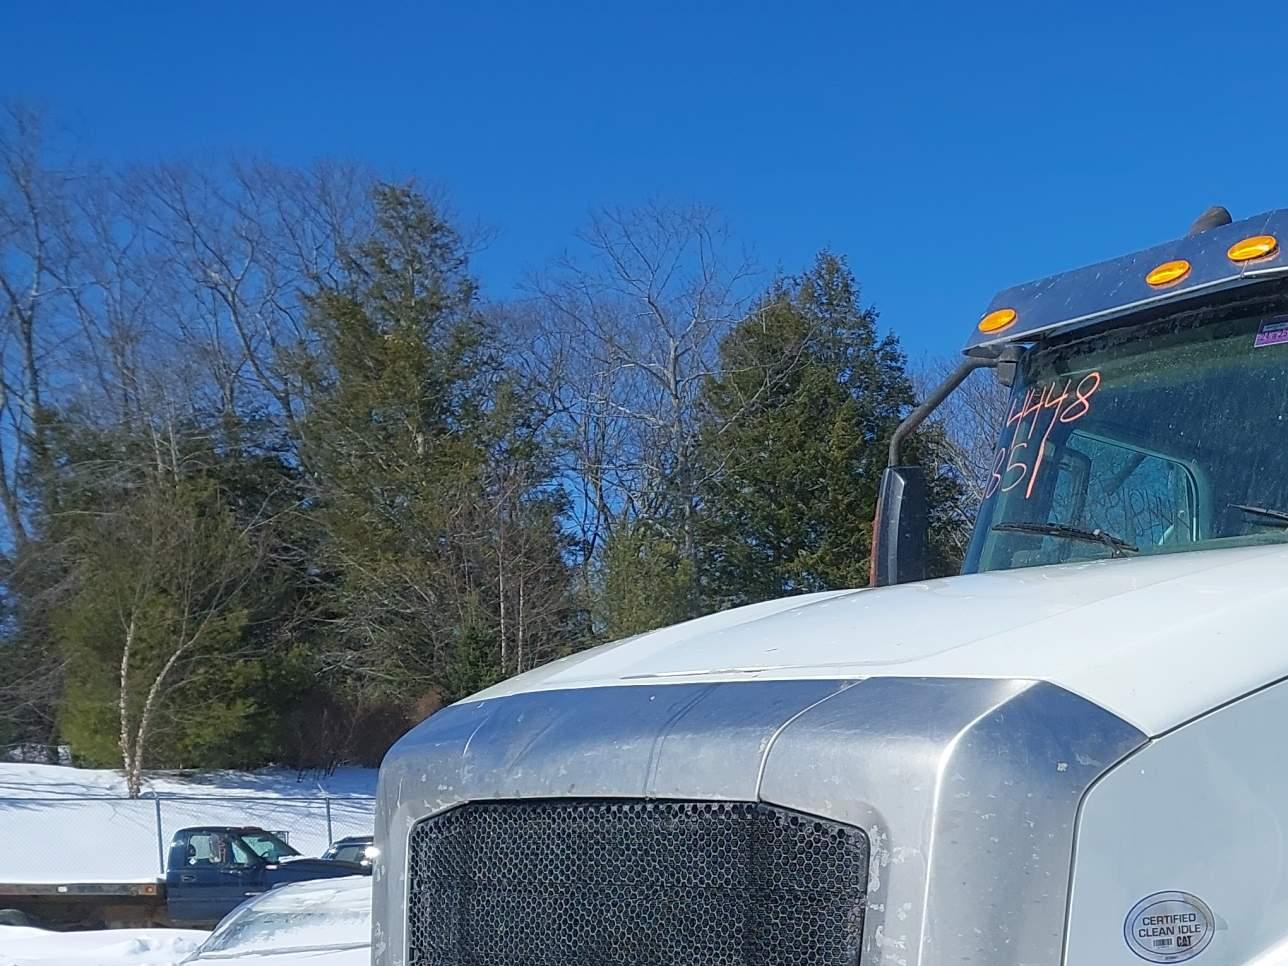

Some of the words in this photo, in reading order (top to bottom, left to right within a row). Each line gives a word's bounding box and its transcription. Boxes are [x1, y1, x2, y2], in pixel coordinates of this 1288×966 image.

[1142, 913, 1197, 926] CERTIFIED
[1138, 926, 1175, 938] CLEAN
[1178, 924, 1201, 935] IDLE
[1176, 935, 1192, 948] CAT
